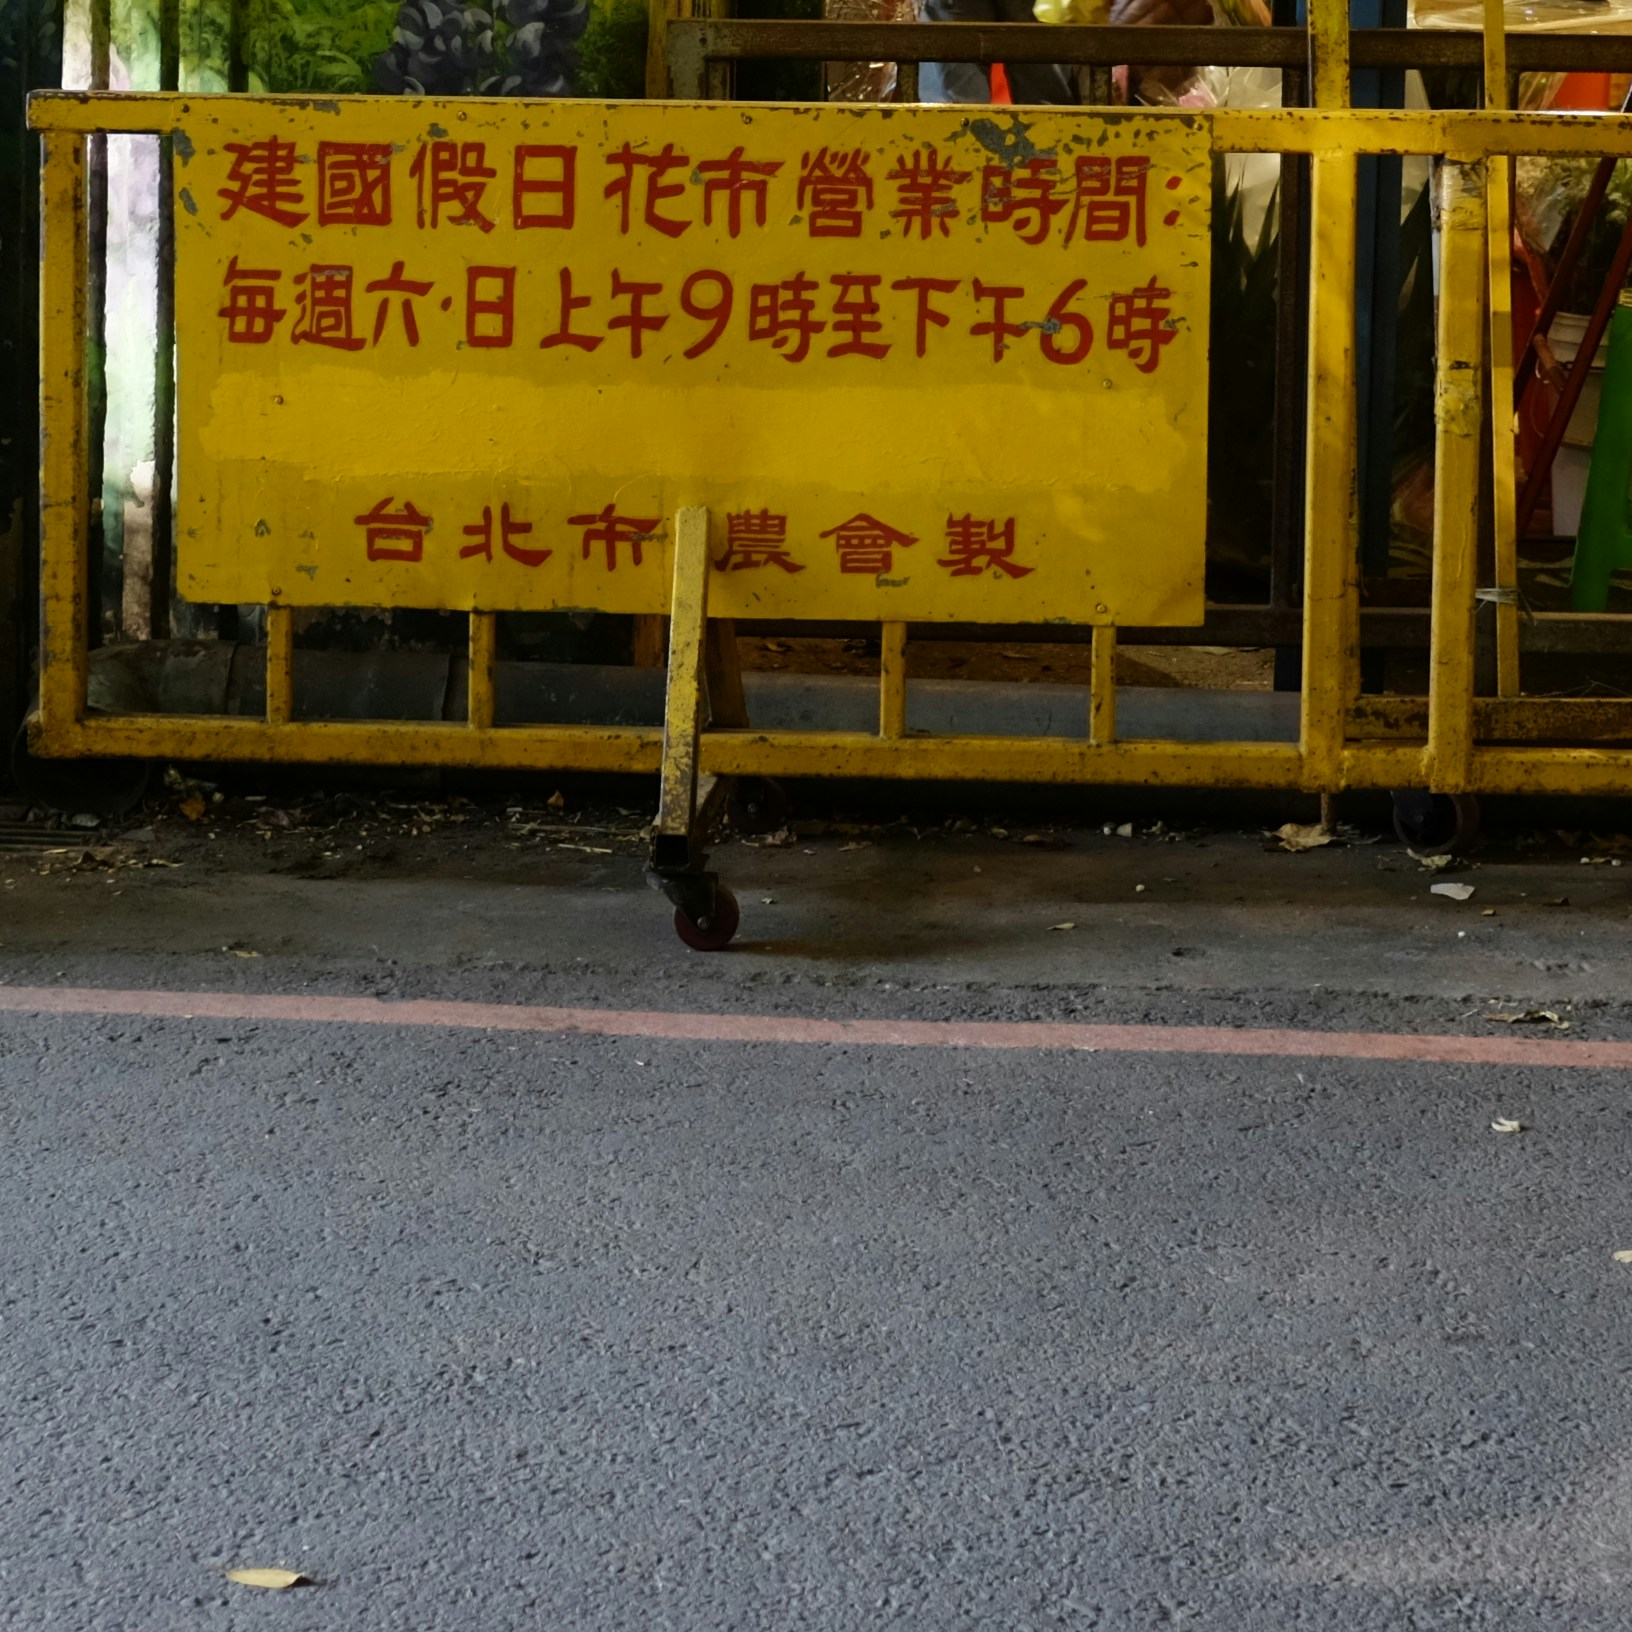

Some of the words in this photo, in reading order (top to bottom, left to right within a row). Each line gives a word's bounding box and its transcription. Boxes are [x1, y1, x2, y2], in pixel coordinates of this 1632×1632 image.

[354, 496, 1036, 579] 台北市農會製
